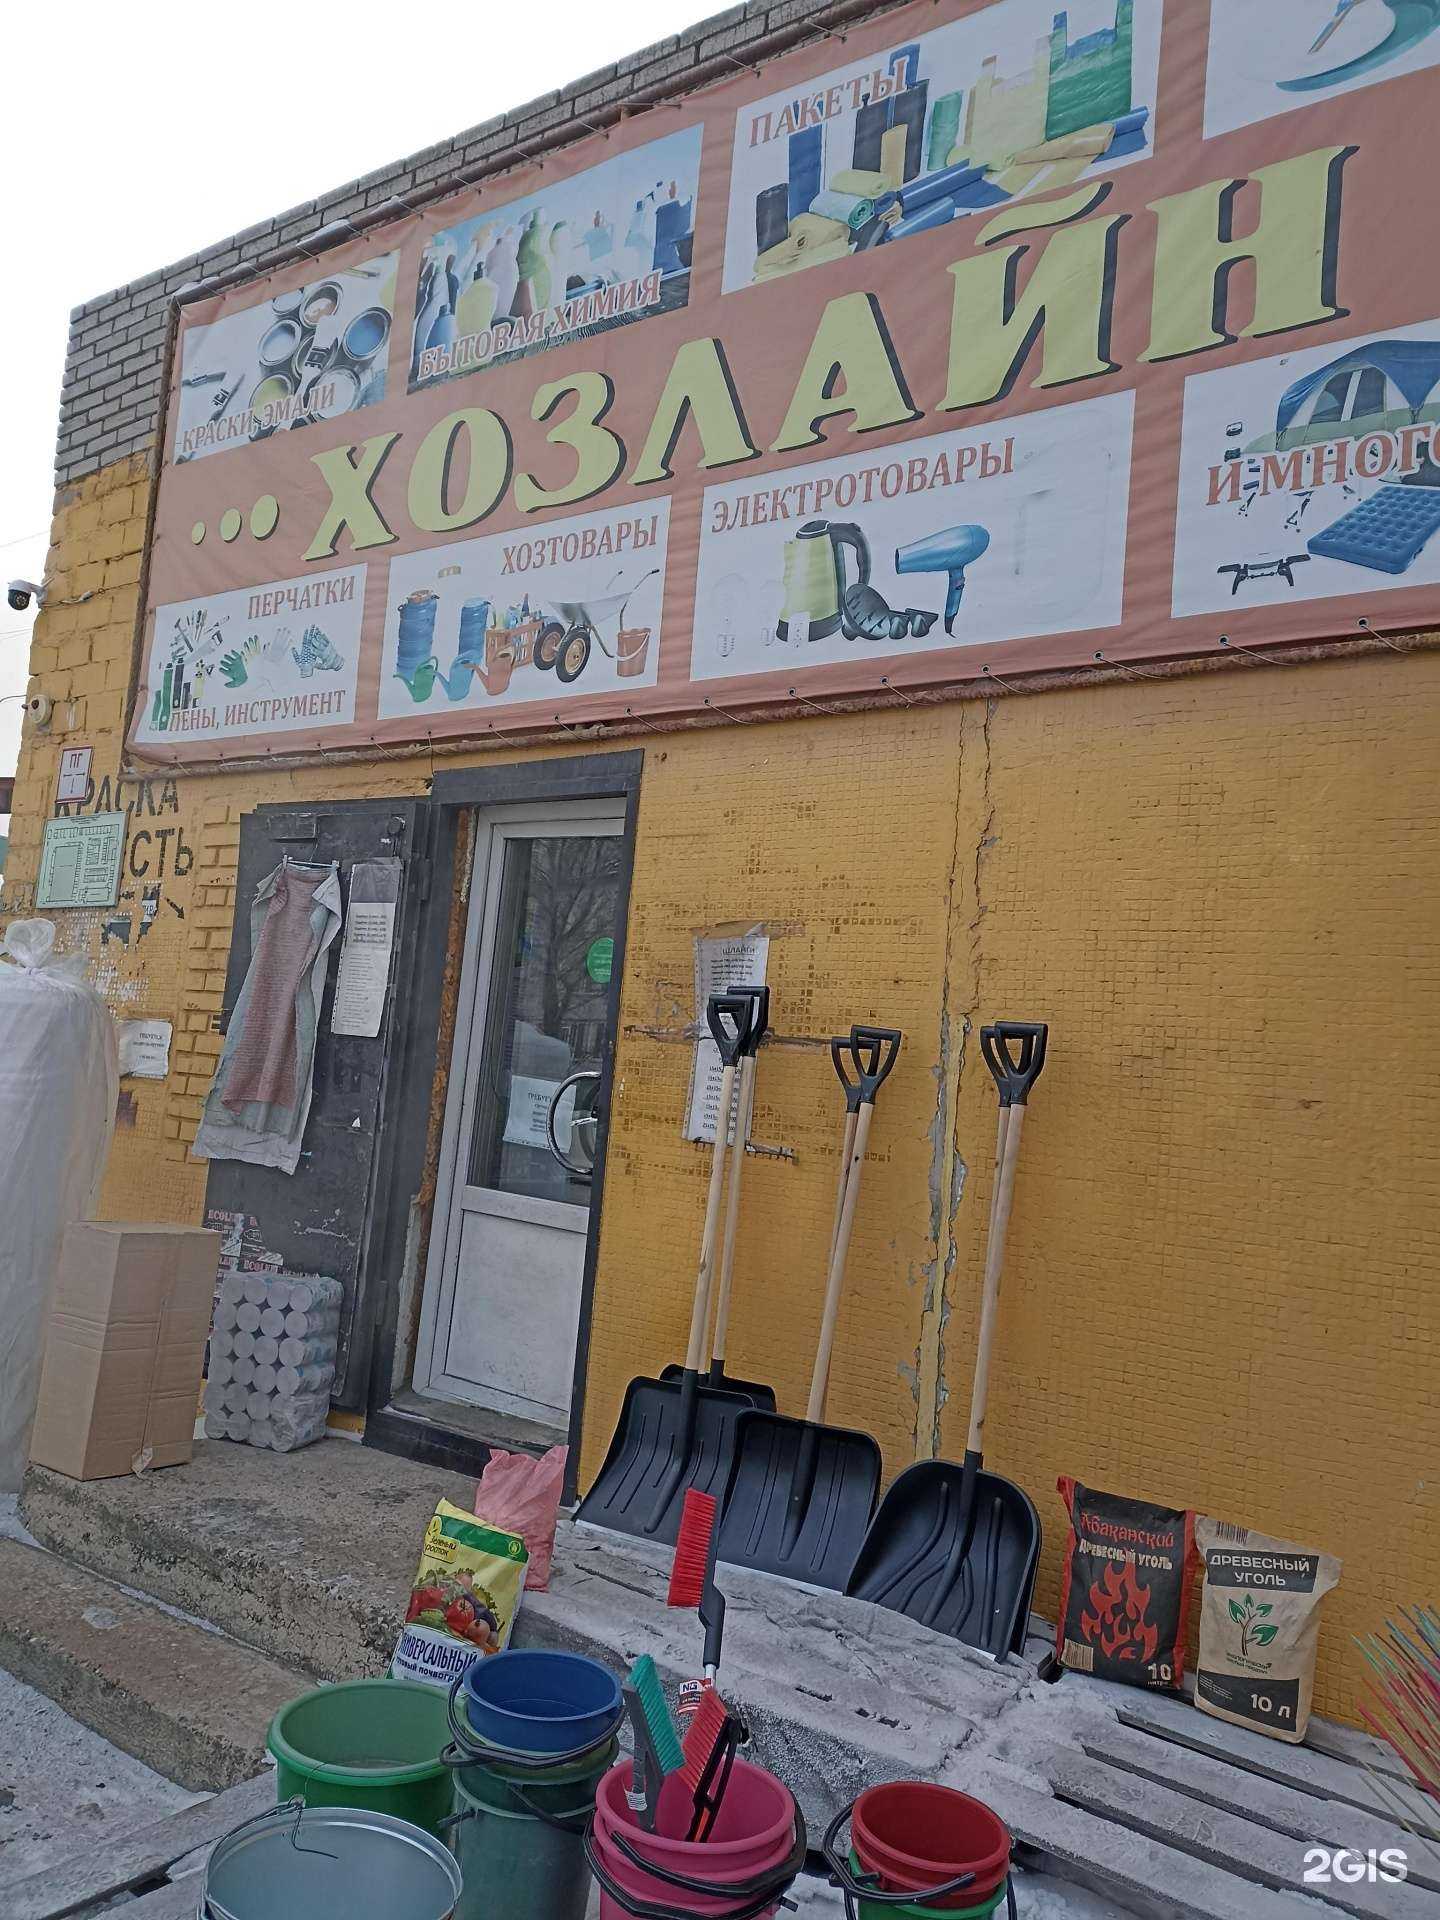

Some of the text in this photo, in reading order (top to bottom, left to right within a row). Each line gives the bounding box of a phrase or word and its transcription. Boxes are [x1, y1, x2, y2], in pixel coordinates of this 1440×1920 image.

[749, 58, 910, 149] ПАКЕТЫ
[419, 270, 663, 379] БЫТОВАЯ ХИМИЯ
[182, 382, 336, 453] КРАСКИ, ЭМАЛИ
[711, 436, 1016, 535] ЭЛЕКТРОТОВАРЫ
[1205, 424, 1440, 506] И МНОГ
[501, 515, 658, 575] ХОЗТОВАРЫ
[248, 575, 356, 621] ПЕРЧАТКИ
[168, 690, 346, 733] ПЕНЫ, ИНСТРУМЕНТ
[69, 753, 83, 769] ПГ
[54, 775, 179, 818] РАСКА
[122, 826, 194, 879] СТЬ
[1081, 1512, 1174, 1550] Абаканский
[1079, 1538, 1173, 1570] ДРЕВЕСНЫЙ УГОЛЬ
[1209, 1553, 1310, 1572] ДРЕВЕСНЫЙ
[1234, 1571, 1287, 1586] УГОЛЬ
[1147, 1662, 1171, 1681] 10
[1251, 1693, 1272, 1712] 10
